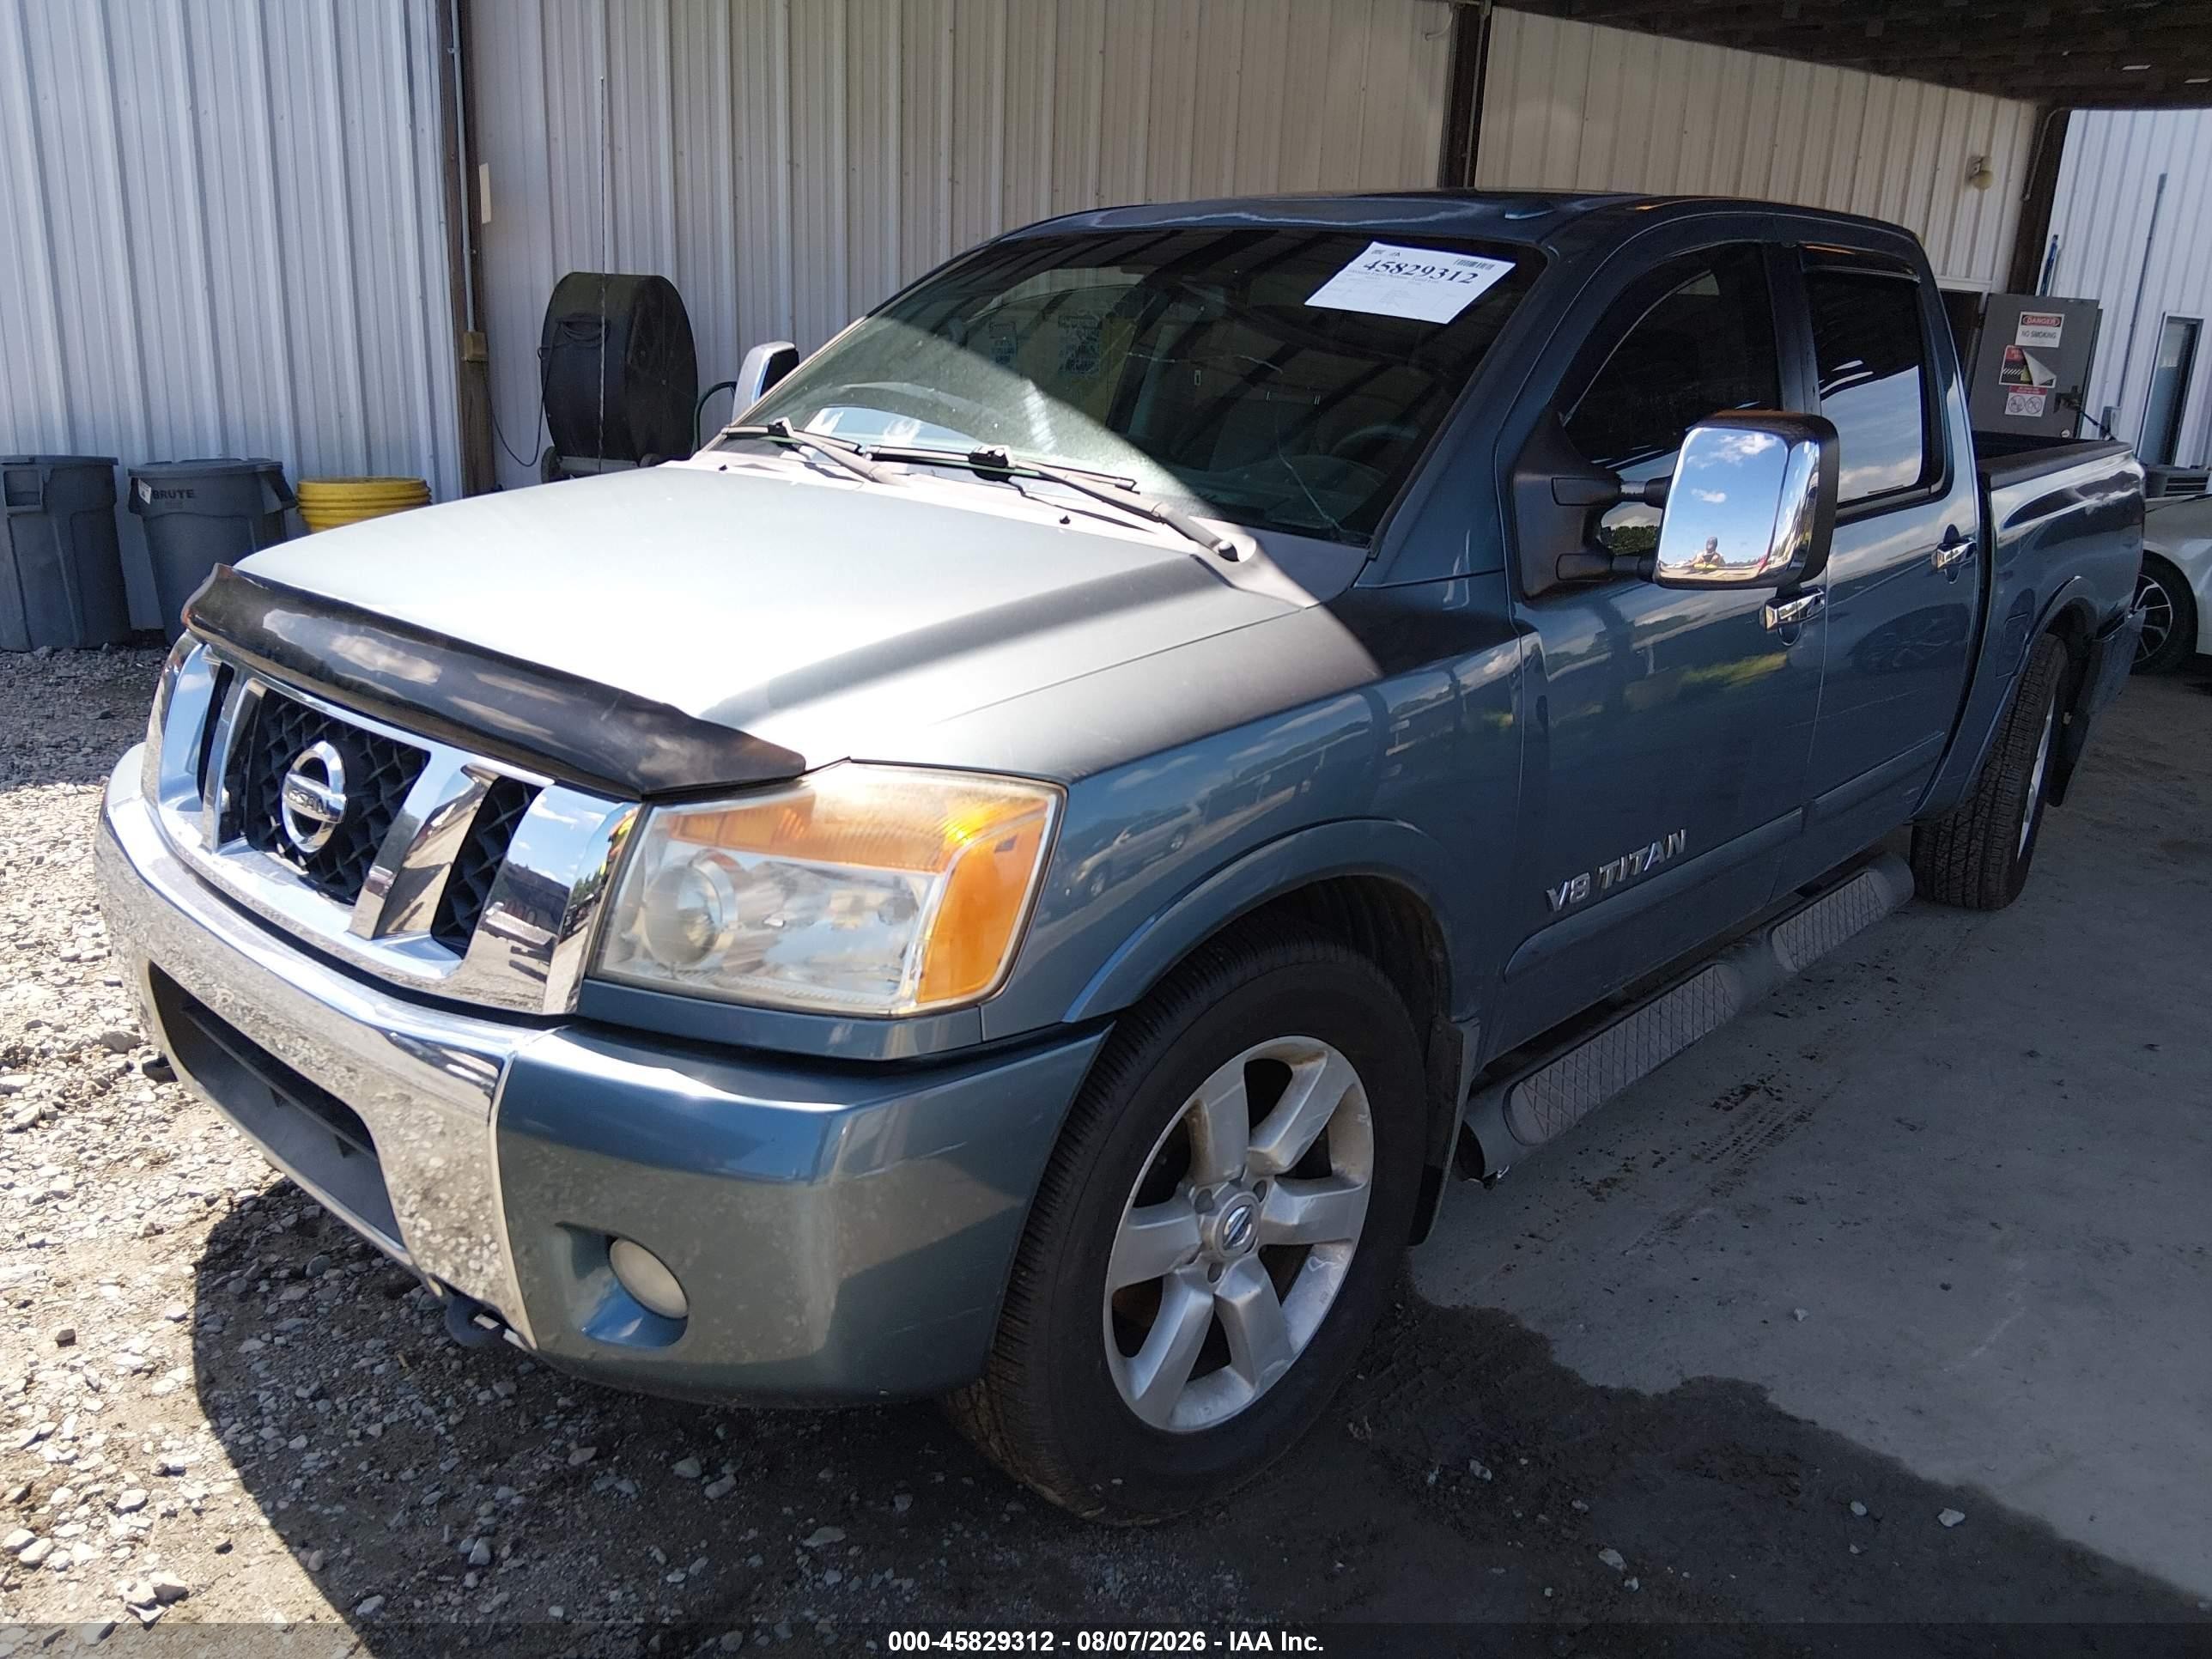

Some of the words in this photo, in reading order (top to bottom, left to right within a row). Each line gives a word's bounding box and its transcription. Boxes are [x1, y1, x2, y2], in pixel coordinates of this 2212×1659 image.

[1364, 260, 1479, 284] 45829312
[2027, 316, 2057, 325] DANGER
[2031, 331, 2057, 339] SMOKING
[153, 489, 194, 500] BRUTE
[1547, 872, 1590, 912] V8
[1598, 830, 1686, 890] TITAN
